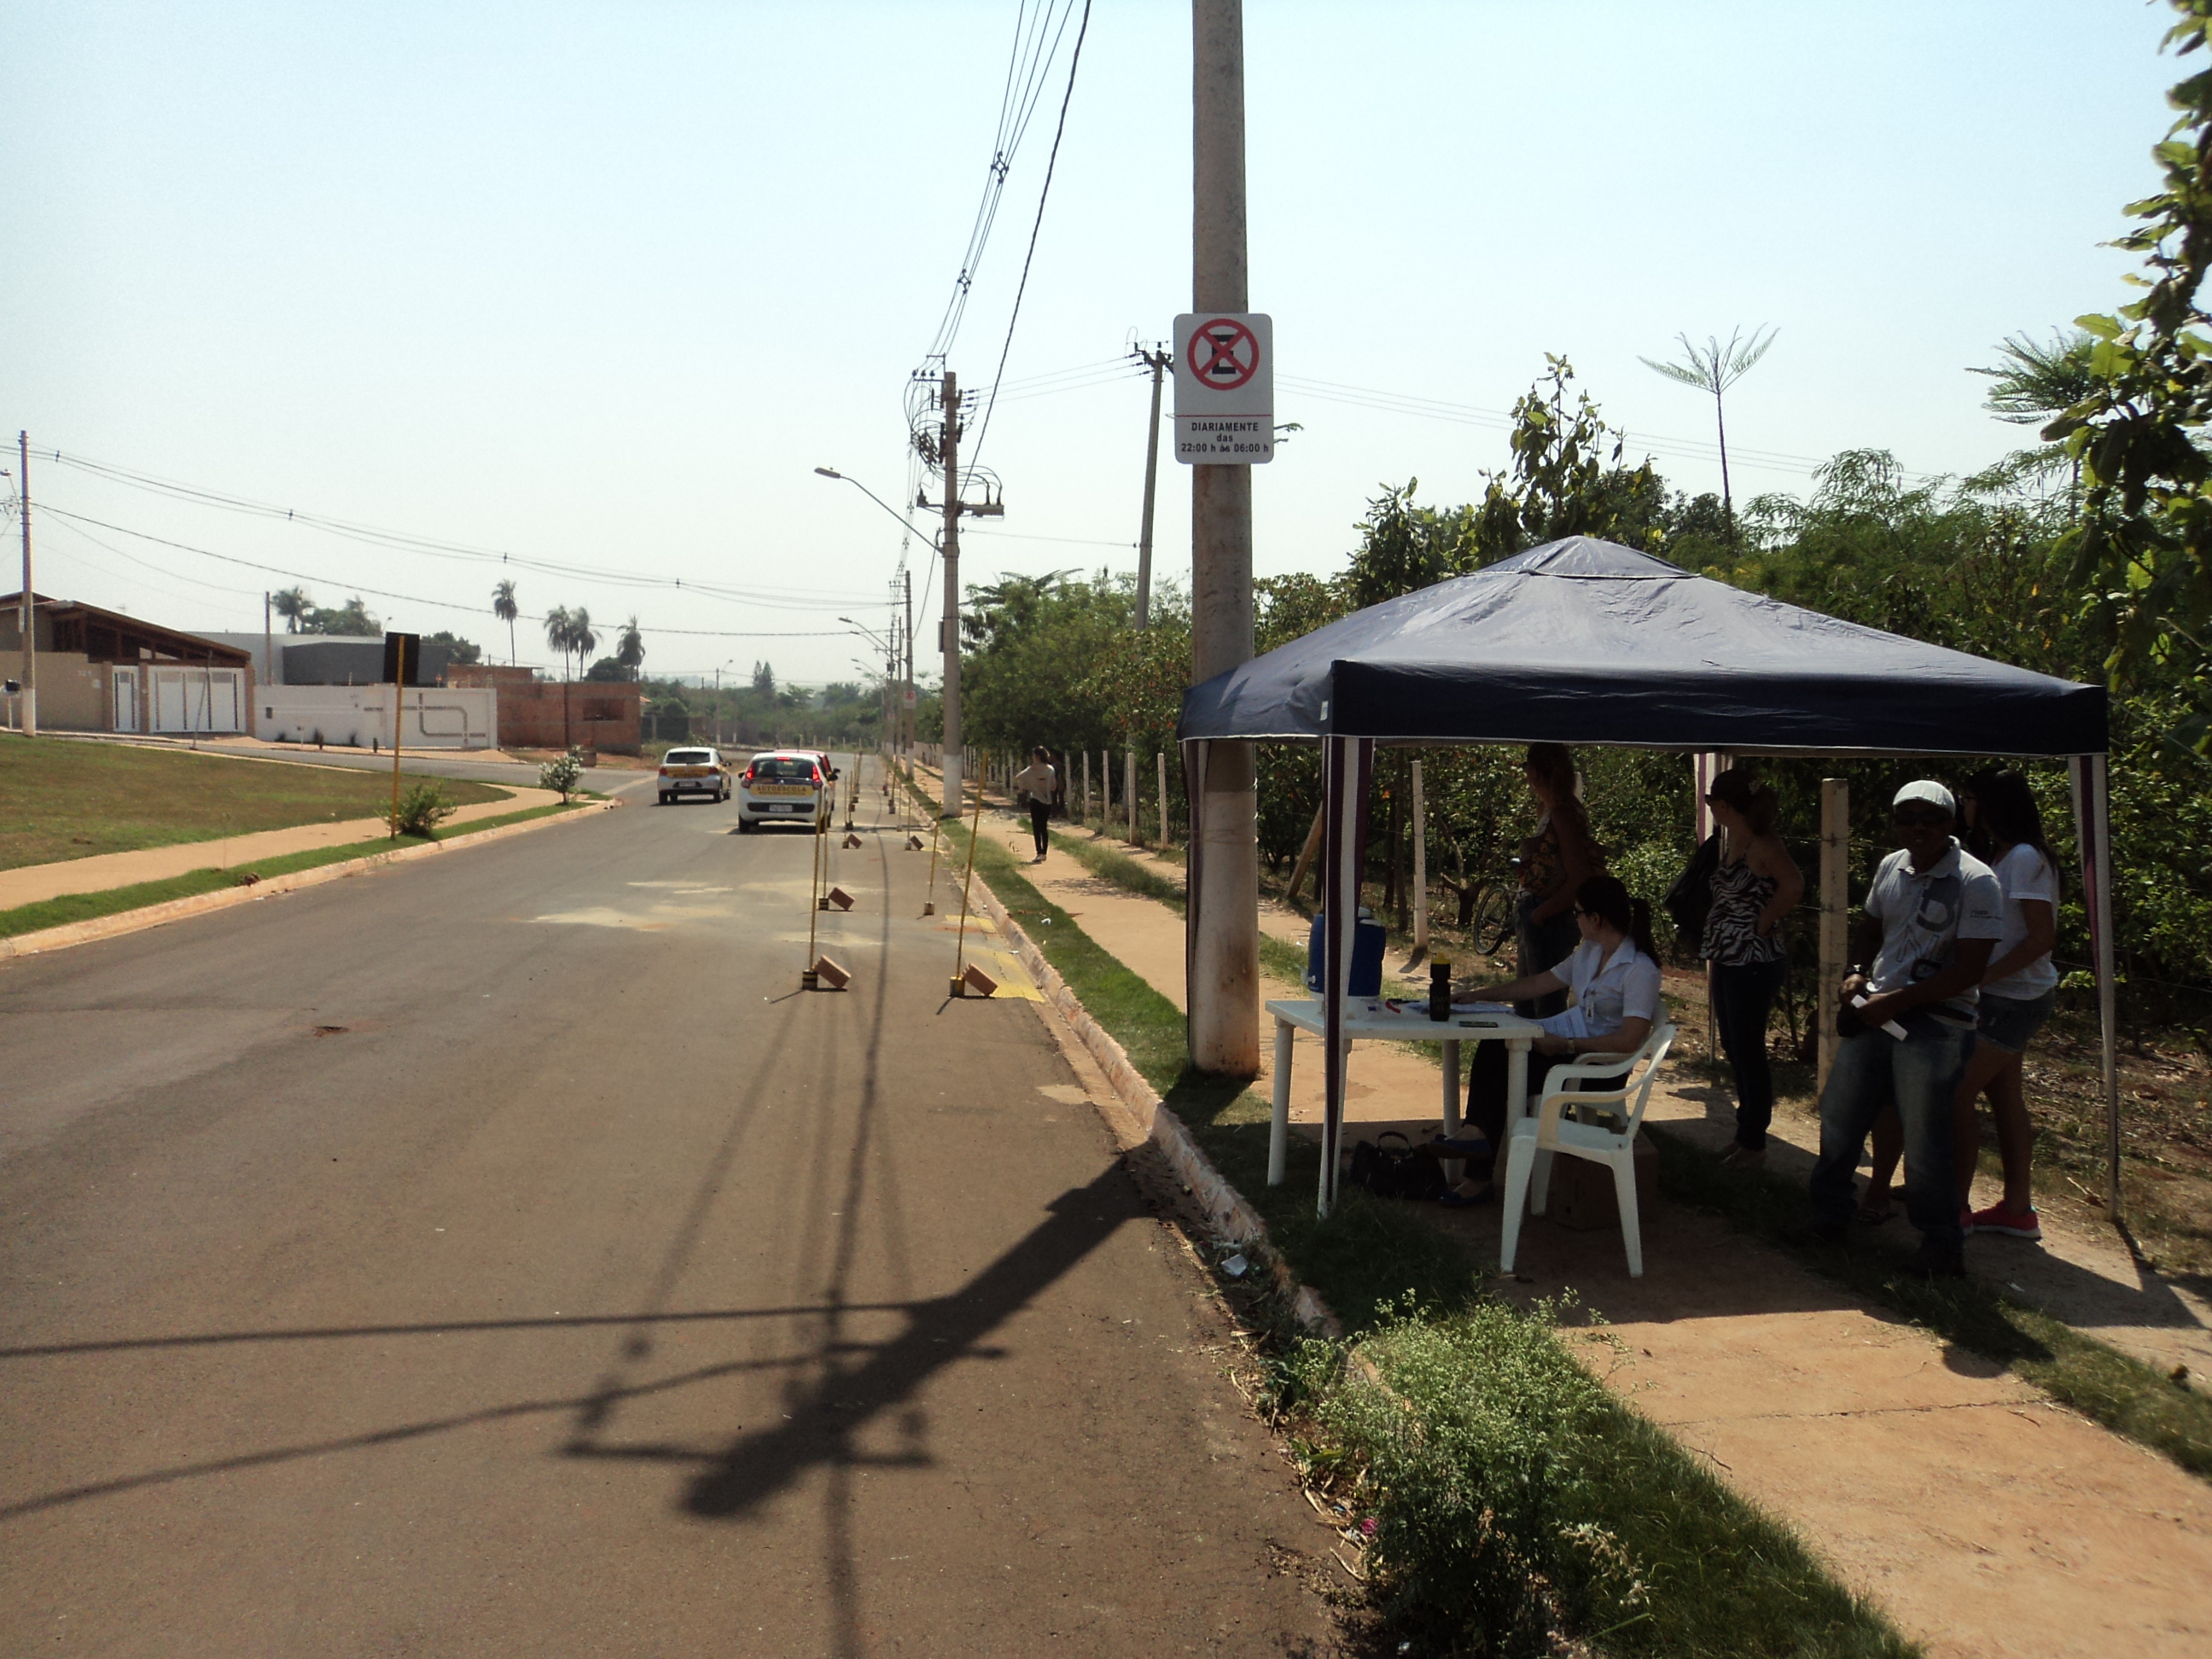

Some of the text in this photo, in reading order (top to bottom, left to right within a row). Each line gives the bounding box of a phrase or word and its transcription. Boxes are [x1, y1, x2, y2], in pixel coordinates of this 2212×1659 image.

[1191, 422, 1259, 432] DIARIAMENTE
[1216, 433, 1233, 442] das
[1181, 443, 1208, 452] 22:00
[1210, 443, 1216, 452] h
[1234, 443, 1260, 452] 06:00
[1263, 443, 1269, 452] h
